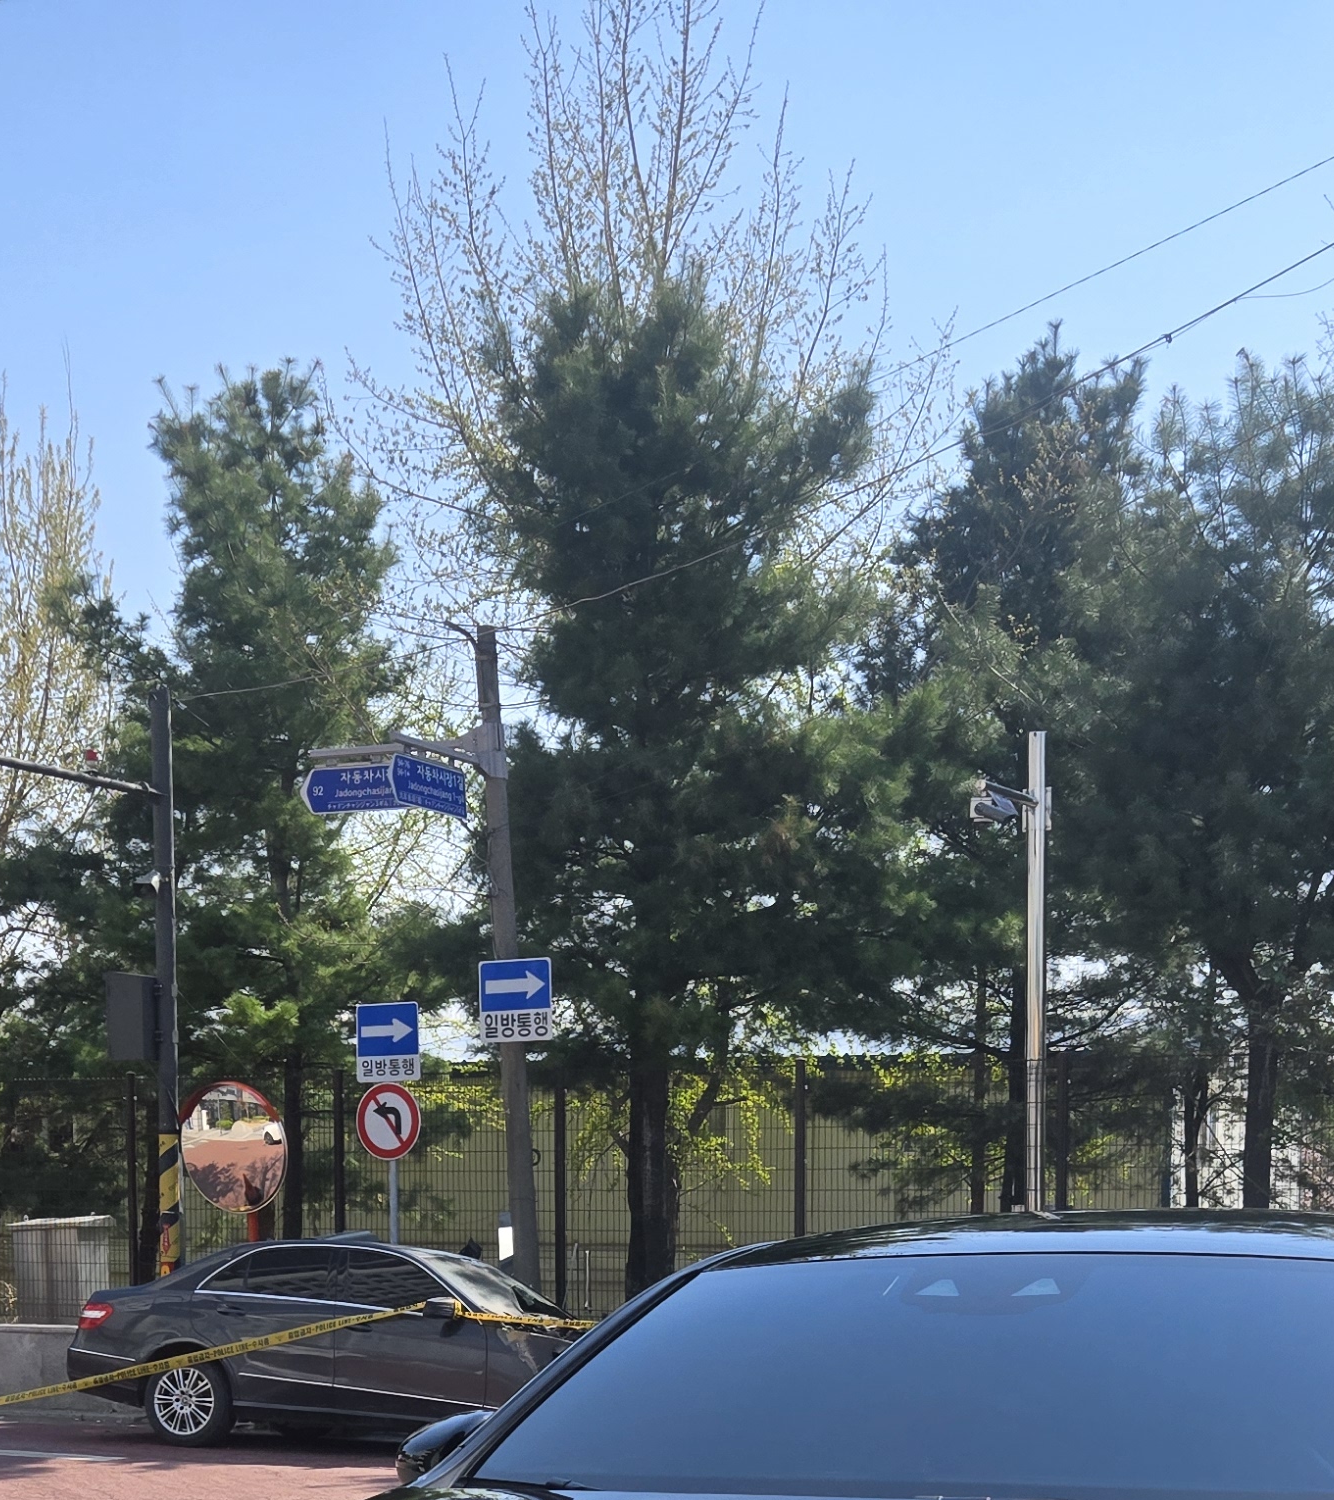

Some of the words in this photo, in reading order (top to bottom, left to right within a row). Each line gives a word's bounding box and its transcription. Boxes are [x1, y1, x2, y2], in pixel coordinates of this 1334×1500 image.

[340, 768, 389, 784] 자동차시
[312, 786, 324, 797] 92
[334, 786, 393, 798] Jadongchasijan
[484, 1011, 548, 1038] 일방통행
[361, 1058, 415, 1077] 일방통행
